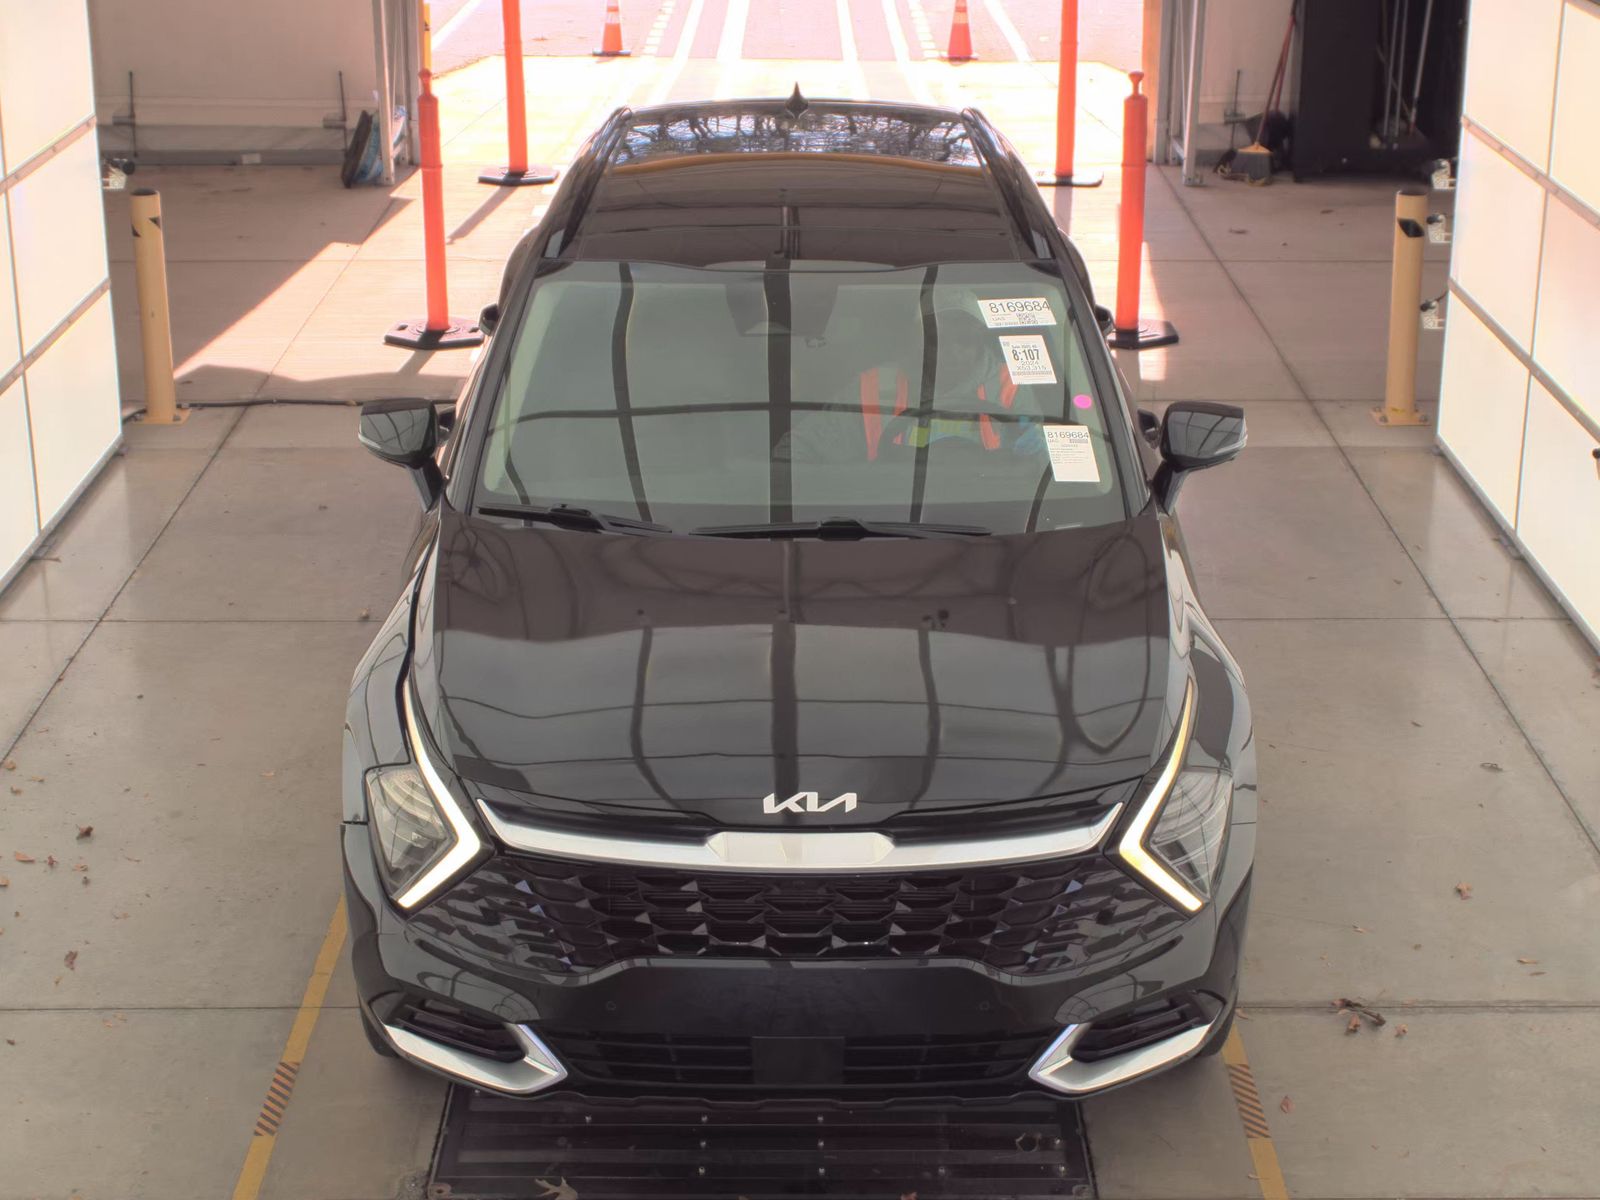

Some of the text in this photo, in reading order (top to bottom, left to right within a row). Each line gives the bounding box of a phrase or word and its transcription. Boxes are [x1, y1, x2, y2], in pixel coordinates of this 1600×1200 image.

[989, 301, 1050, 313] 8169684
[1012, 349, 1040, 361] 8:107
[1047, 431, 1089, 439] 8169684
[763, 792, 857, 813] KIA
